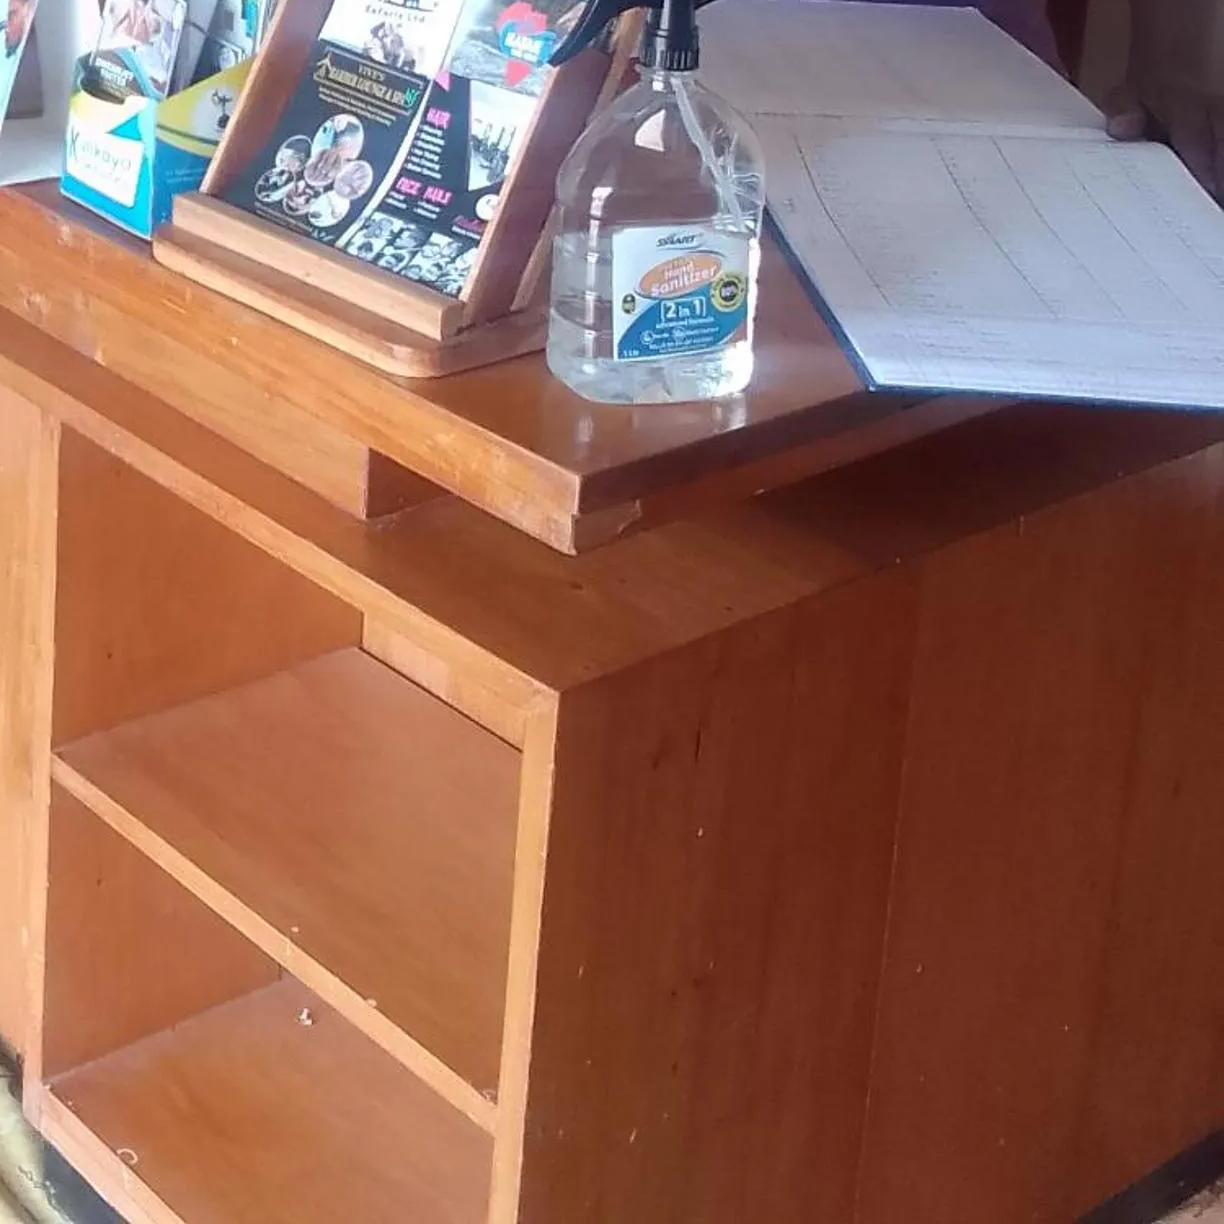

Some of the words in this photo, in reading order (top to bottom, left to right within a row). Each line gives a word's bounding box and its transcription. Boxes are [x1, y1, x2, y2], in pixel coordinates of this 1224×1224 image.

[665, 301, 677, 319] 2
[679, 305, 690, 318] in
[693, 298, 702, 316] 1
